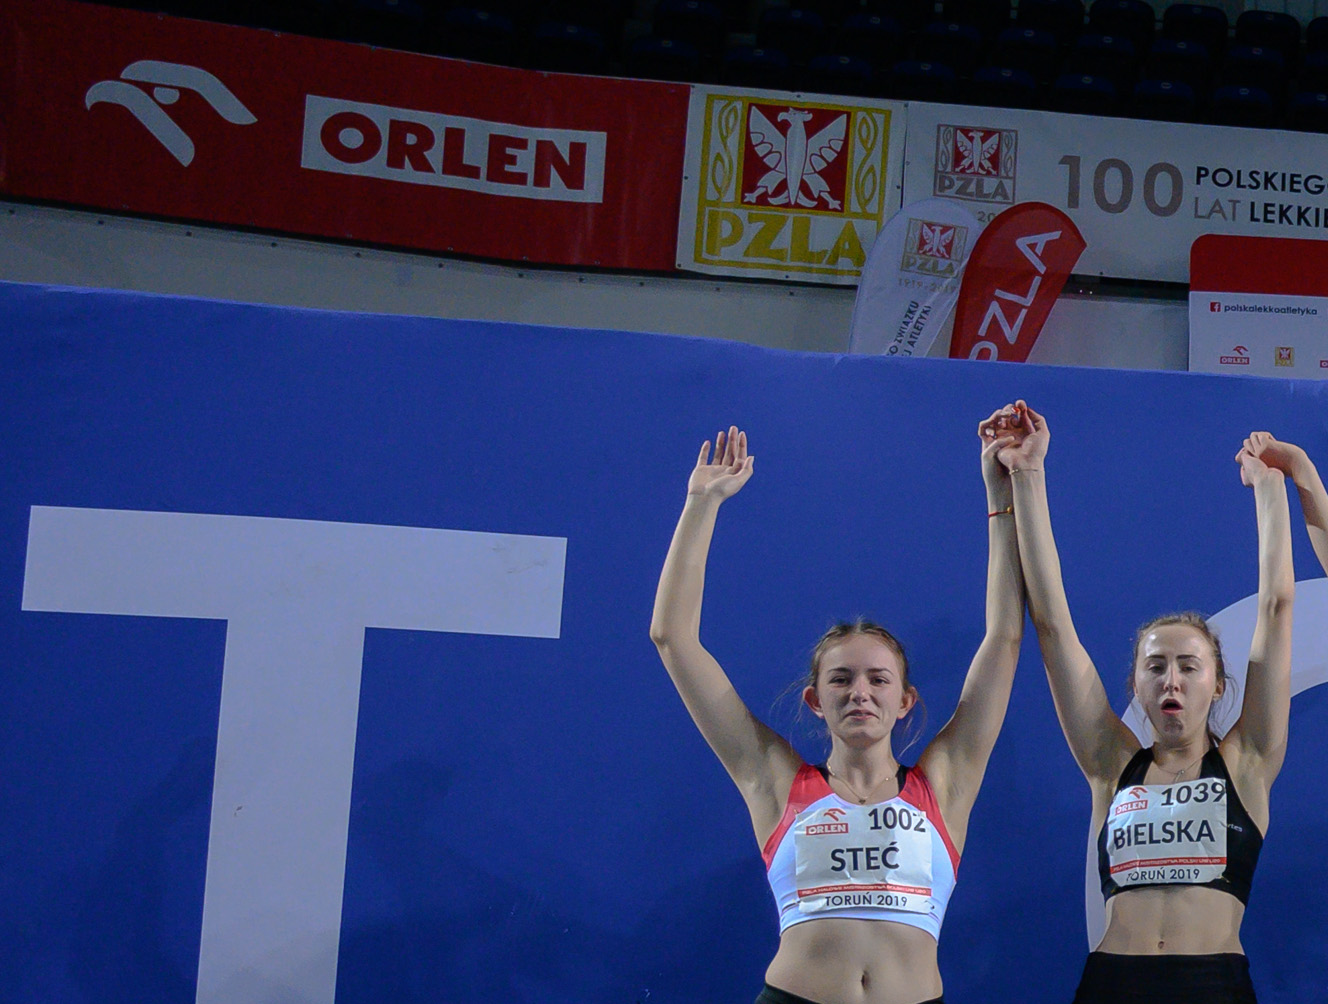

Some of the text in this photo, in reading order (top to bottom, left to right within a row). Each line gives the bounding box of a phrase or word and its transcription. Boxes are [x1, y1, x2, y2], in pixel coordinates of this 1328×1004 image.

[320, 111, 587, 191] ORLEN
[1058, 155, 1184, 217] 100
[1194, 197, 1240, 222] LAT
[706, 211, 868, 269] PZLA
[1116, 782, 1226, 814] ORLEN 1039
[808, 806, 926, 834] ORLEN 1002
[1113, 819, 1216, 850] BIELSKA
[830, 842, 900, 871] STEĆ
[1127, 867, 1200, 882] TORUŃ 2019
[825, 892, 908, 906] TORUŃ 2019
